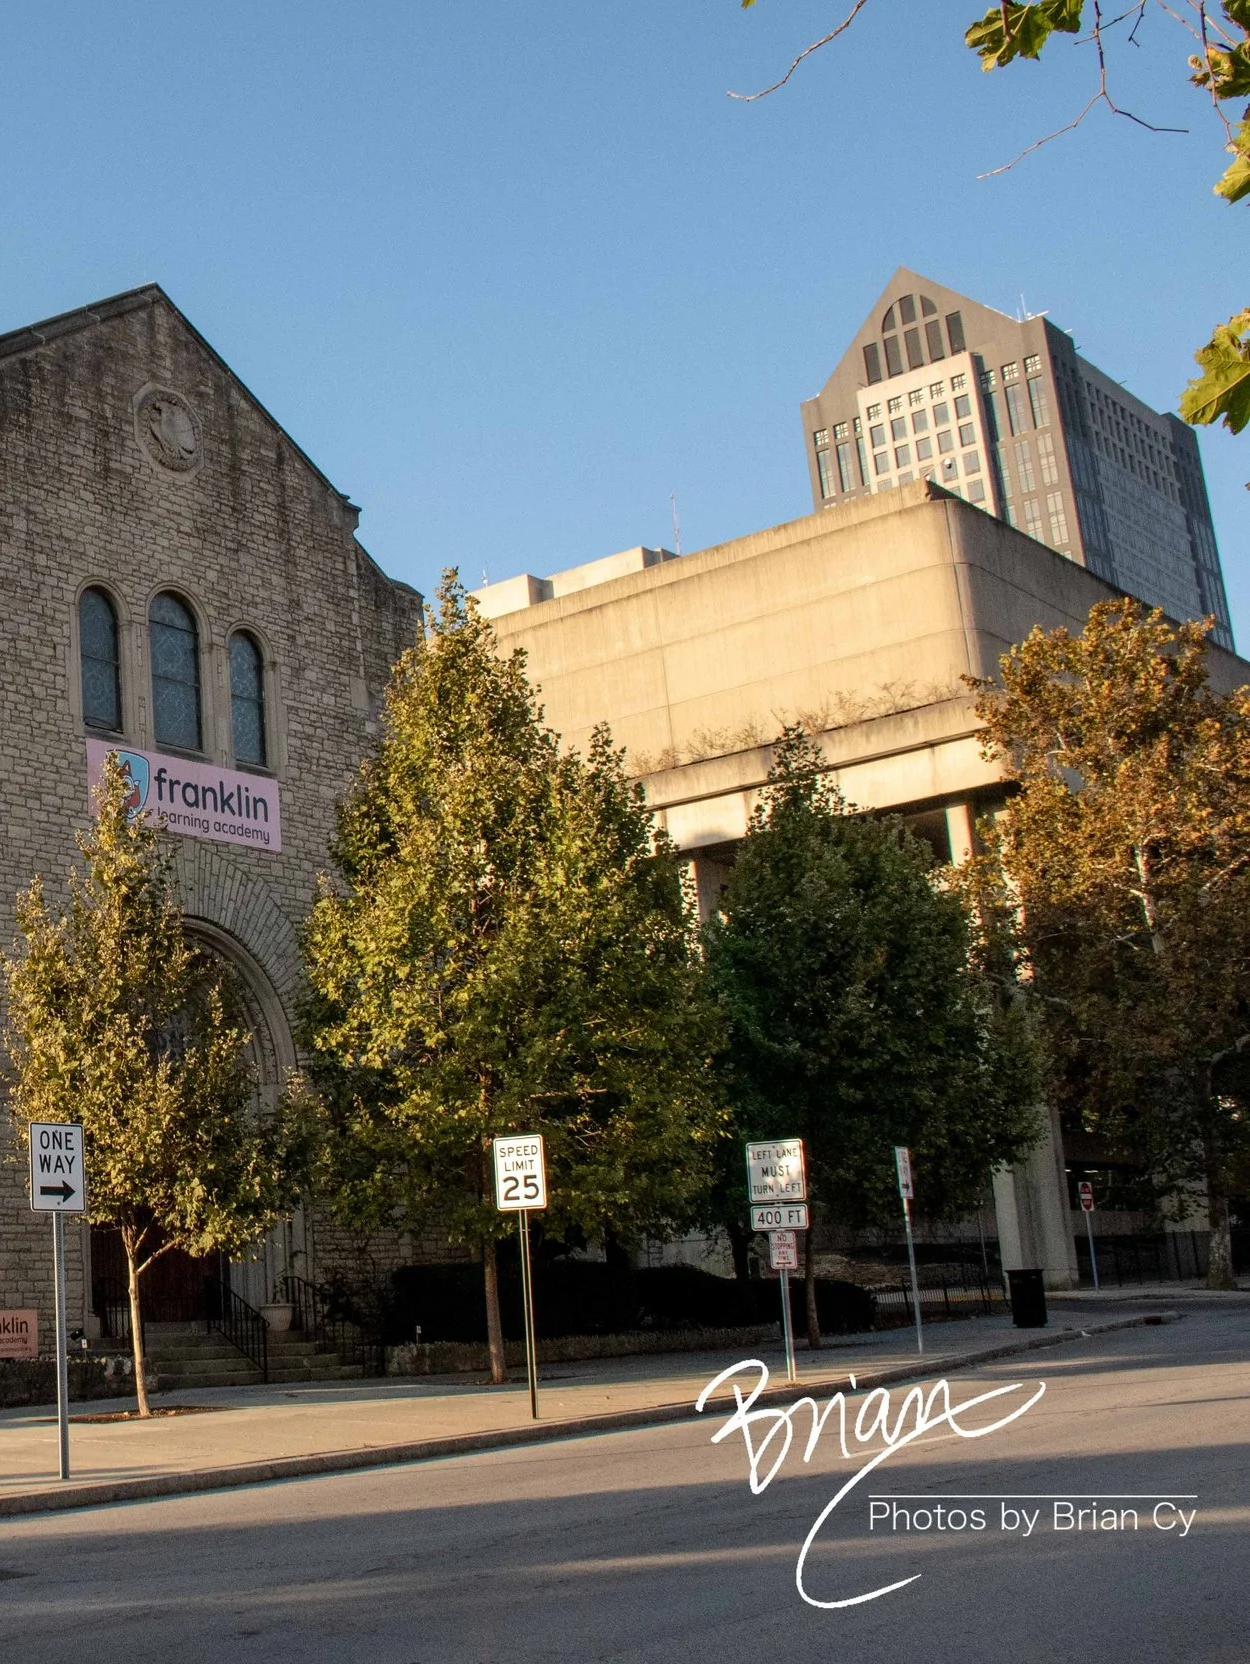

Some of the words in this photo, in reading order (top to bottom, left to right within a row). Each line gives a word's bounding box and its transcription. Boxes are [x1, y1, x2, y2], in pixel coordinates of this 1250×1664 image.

[154, 768, 269, 822] franklin
[213, 821, 270, 844] academy
[40, 1130, 74, 1150] ONE
[499, 1145, 538, 1157] SPEED
[753, 1150, 771, 1160] LEFT
[776, 1147, 797, 1158] LANE
[39, 1154, 75, 1174] WAY
[504, 1160, 534, 1171] LIMIT
[761, 1165, 790, 1177] MUST
[503, 1174, 539, 1201] 25
[753, 1184, 774, 1194] TURN
[780, 1182, 801, 1192] LEFT
[757, 1211, 782, 1225] 400
[788, 1209, 801, 1223] FT
[777, 1234, 787, 1242] NO
